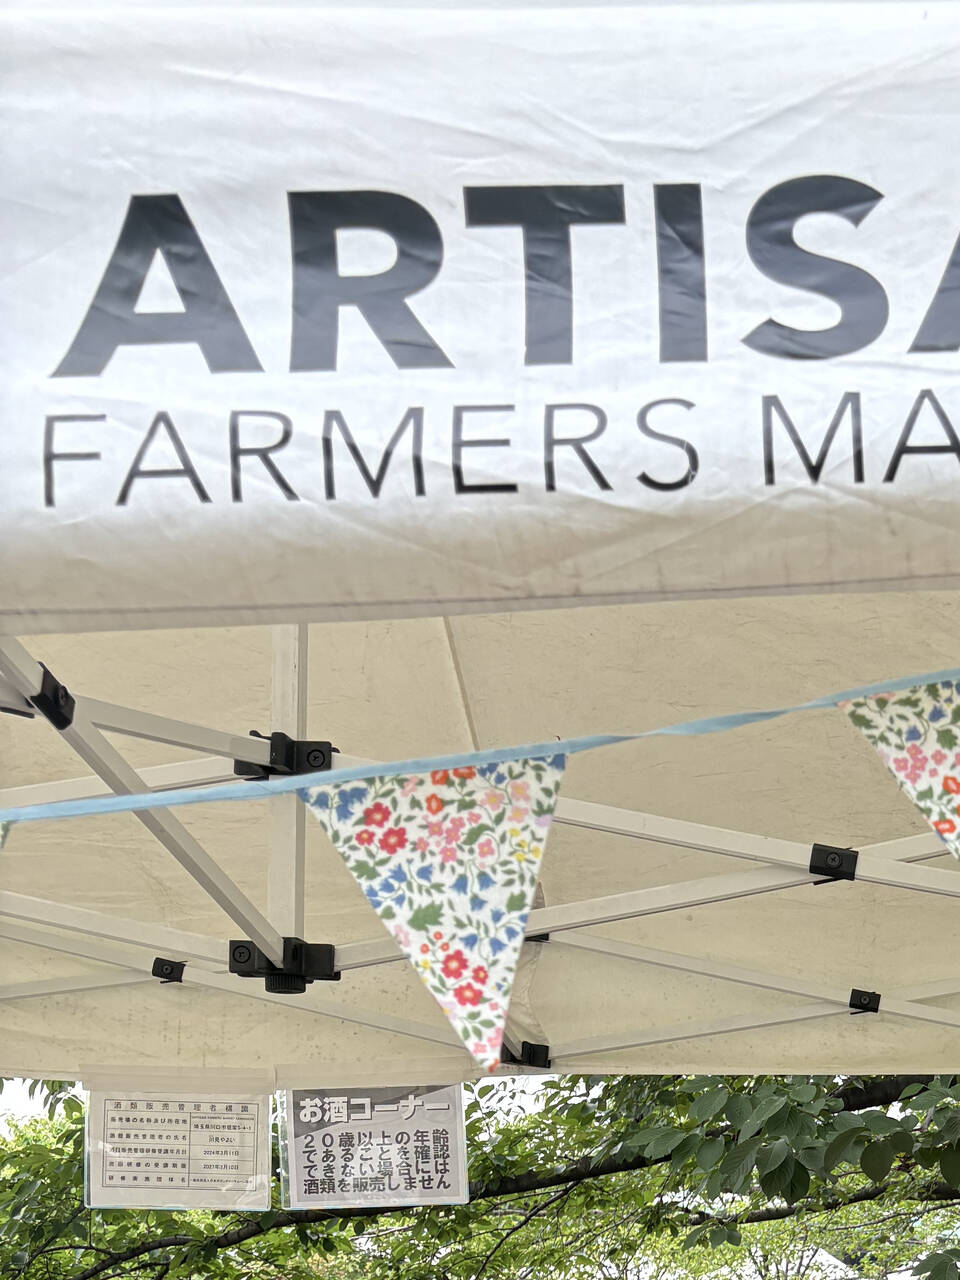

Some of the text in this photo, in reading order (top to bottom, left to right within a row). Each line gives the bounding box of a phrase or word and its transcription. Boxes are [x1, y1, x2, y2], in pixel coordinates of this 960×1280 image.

[43, 396, 699, 508] FARMERS
[299, 1094, 450, 1124] お酒コーナー
[304, 1128, 449, 1148] 20歳以上の年齢
[302, 1144, 450, 1165] であることを確認
[303, 1160, 450, 1179] できない場合には
[303, 1174, 451, 1195] 酒類を販売しません
